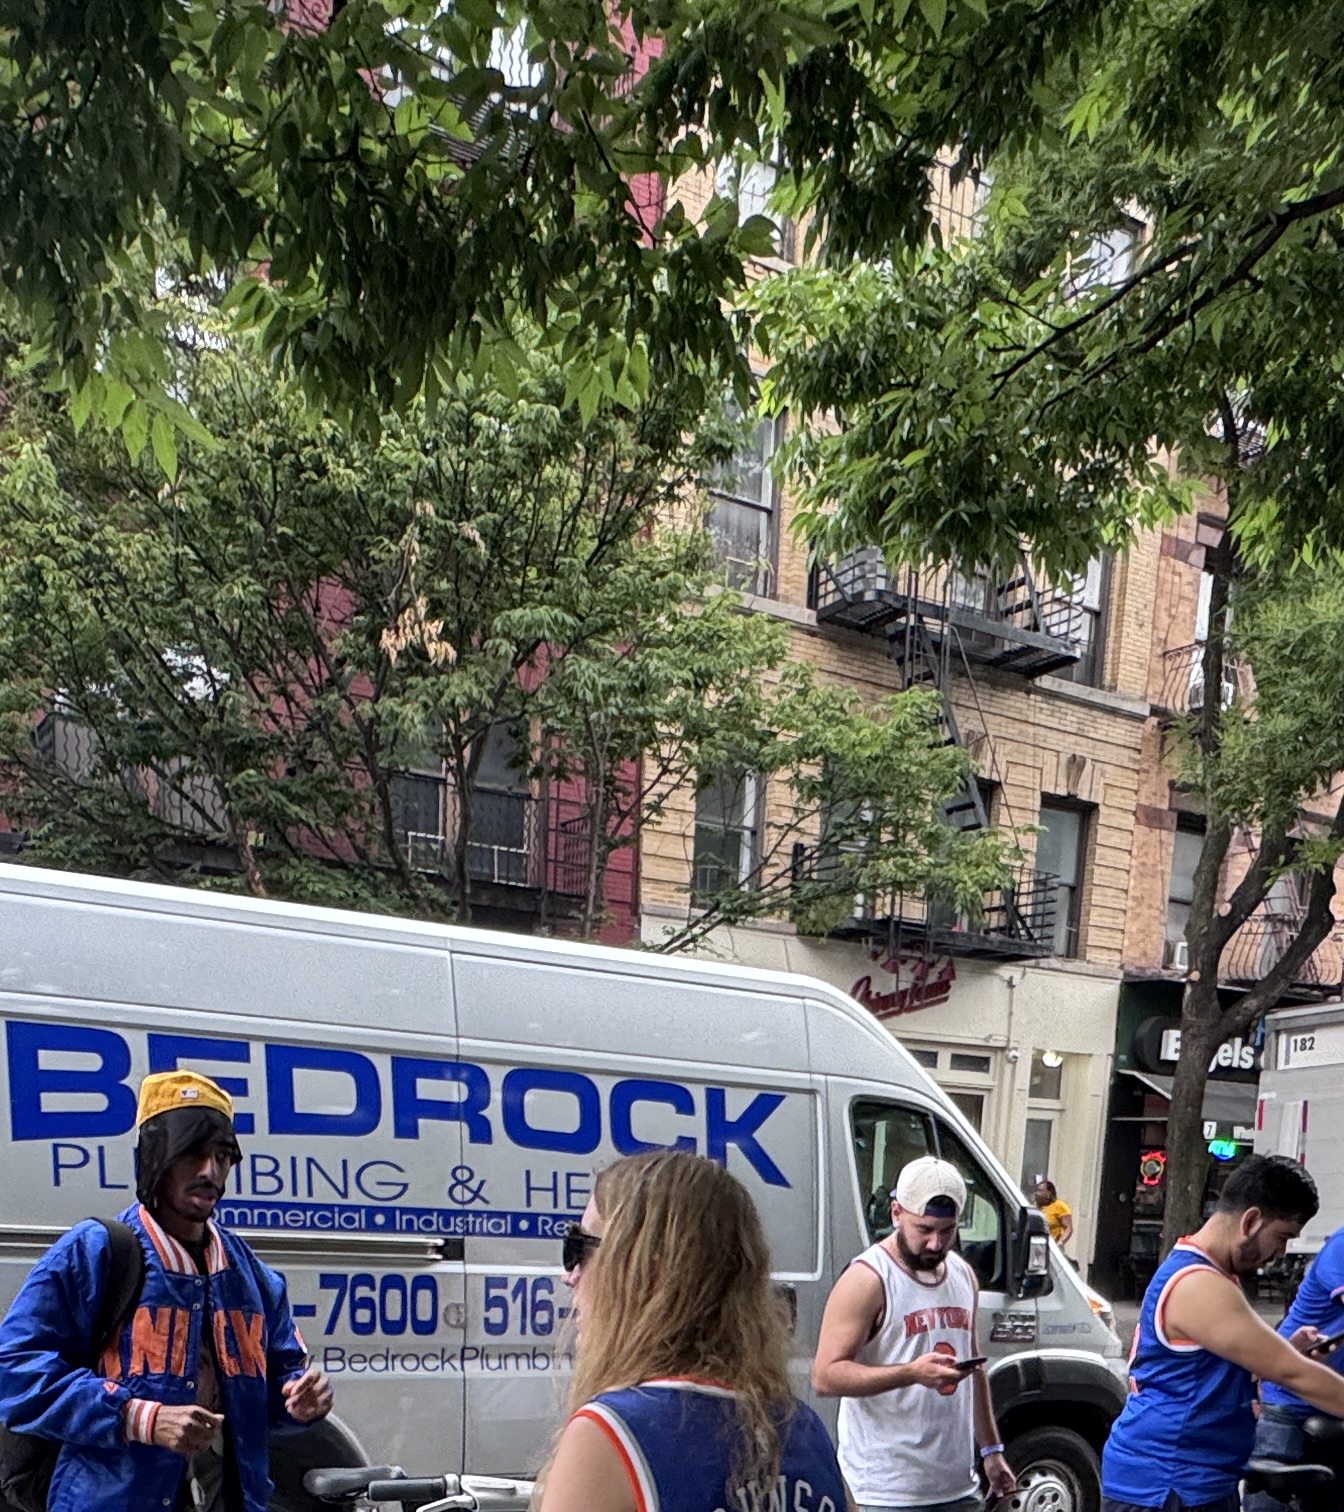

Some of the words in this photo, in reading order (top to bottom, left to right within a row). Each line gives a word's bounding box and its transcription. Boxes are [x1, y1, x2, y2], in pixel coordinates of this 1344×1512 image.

[1292, 1036, 1316, 1053] 182
[6, 1020, 793, 1189] BEDROCK
[52, 1142, 410, 1202] PLBING
[447, 1164, 491, 1206] &
[395, 1208, 512, 1235] Industrial
